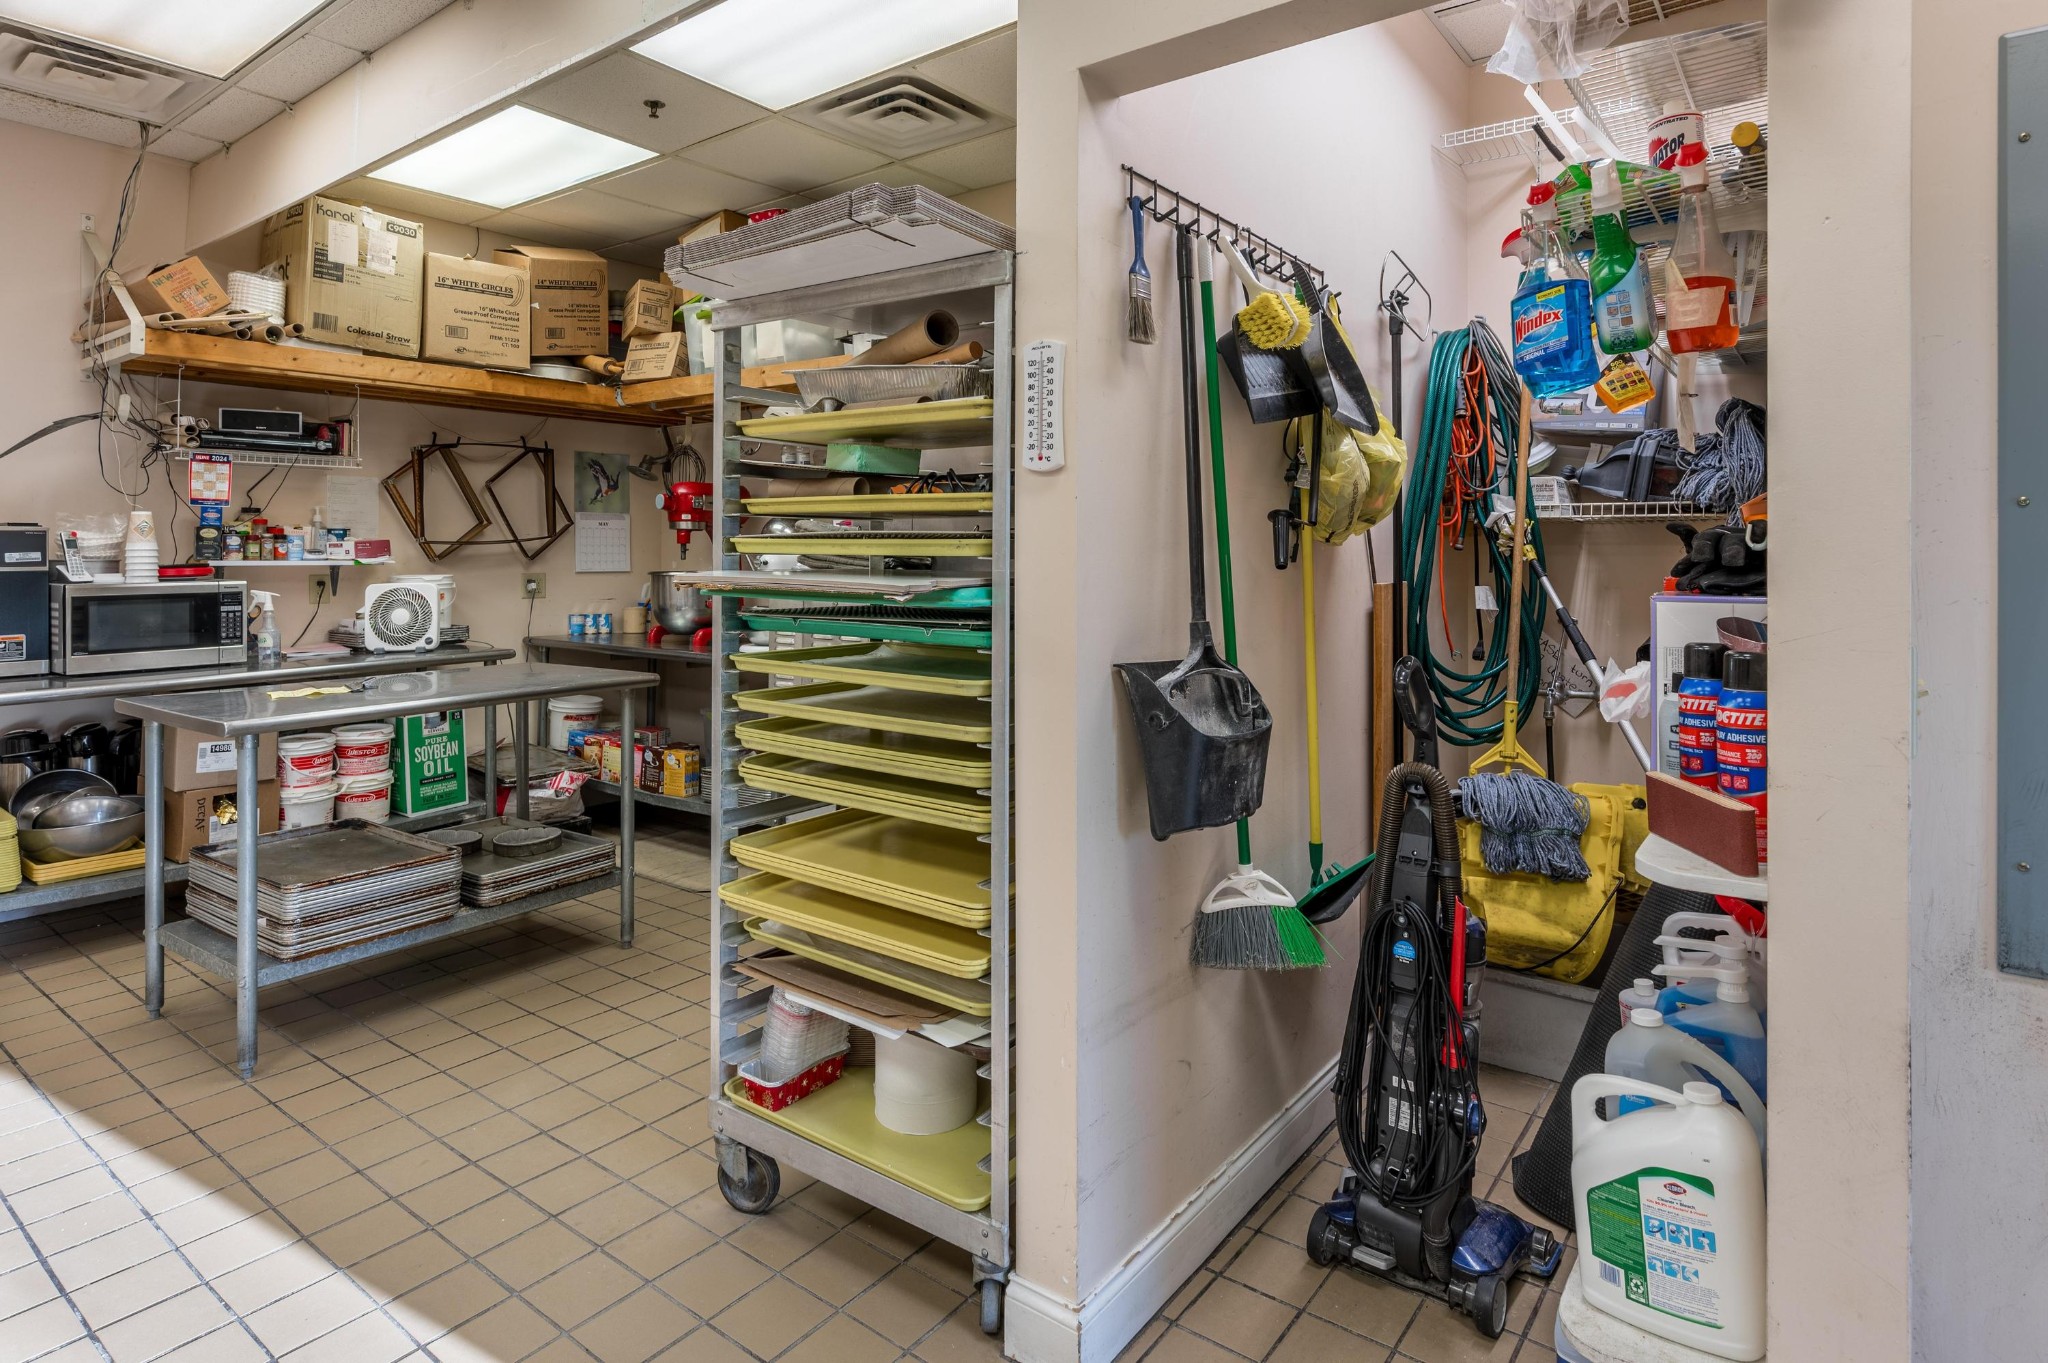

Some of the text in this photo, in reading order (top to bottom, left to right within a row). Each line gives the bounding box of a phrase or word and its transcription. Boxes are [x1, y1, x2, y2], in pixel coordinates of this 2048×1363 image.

[316, 203, 355, 223] Karat
[387, 224, 416, 237] C9030
[451, 278, 479, 288] WHITE
[481, 283, 514, 293] CIRCLES
[346, 325, 411, 343] Colossal Straw
[1515, 309, 1563, 347] Windex
[1524, 349, 1545, 362] ORIGINAL
[1571, 664, 1593, 688] turn
[1717, 709, 1765, 726] OCTITE
[425, 736, 448, 746] PURE
[1727, 732, 1766, 744] ADHESIVE
[347, 748, 376, 756] WESTCO
[414, 740, 459, 763] SOYBEAN
[423, 758, 453, 777] OIL
[347, 794, 374, 803] WESTCO
[194, 797, 206, 834] DECAF
[1666, 1184, 1684, 1193] CLOROX
[1657, 1196, 1675, 1205] Cleaner
[1679, 1202, 1696, 1210] Bleach
